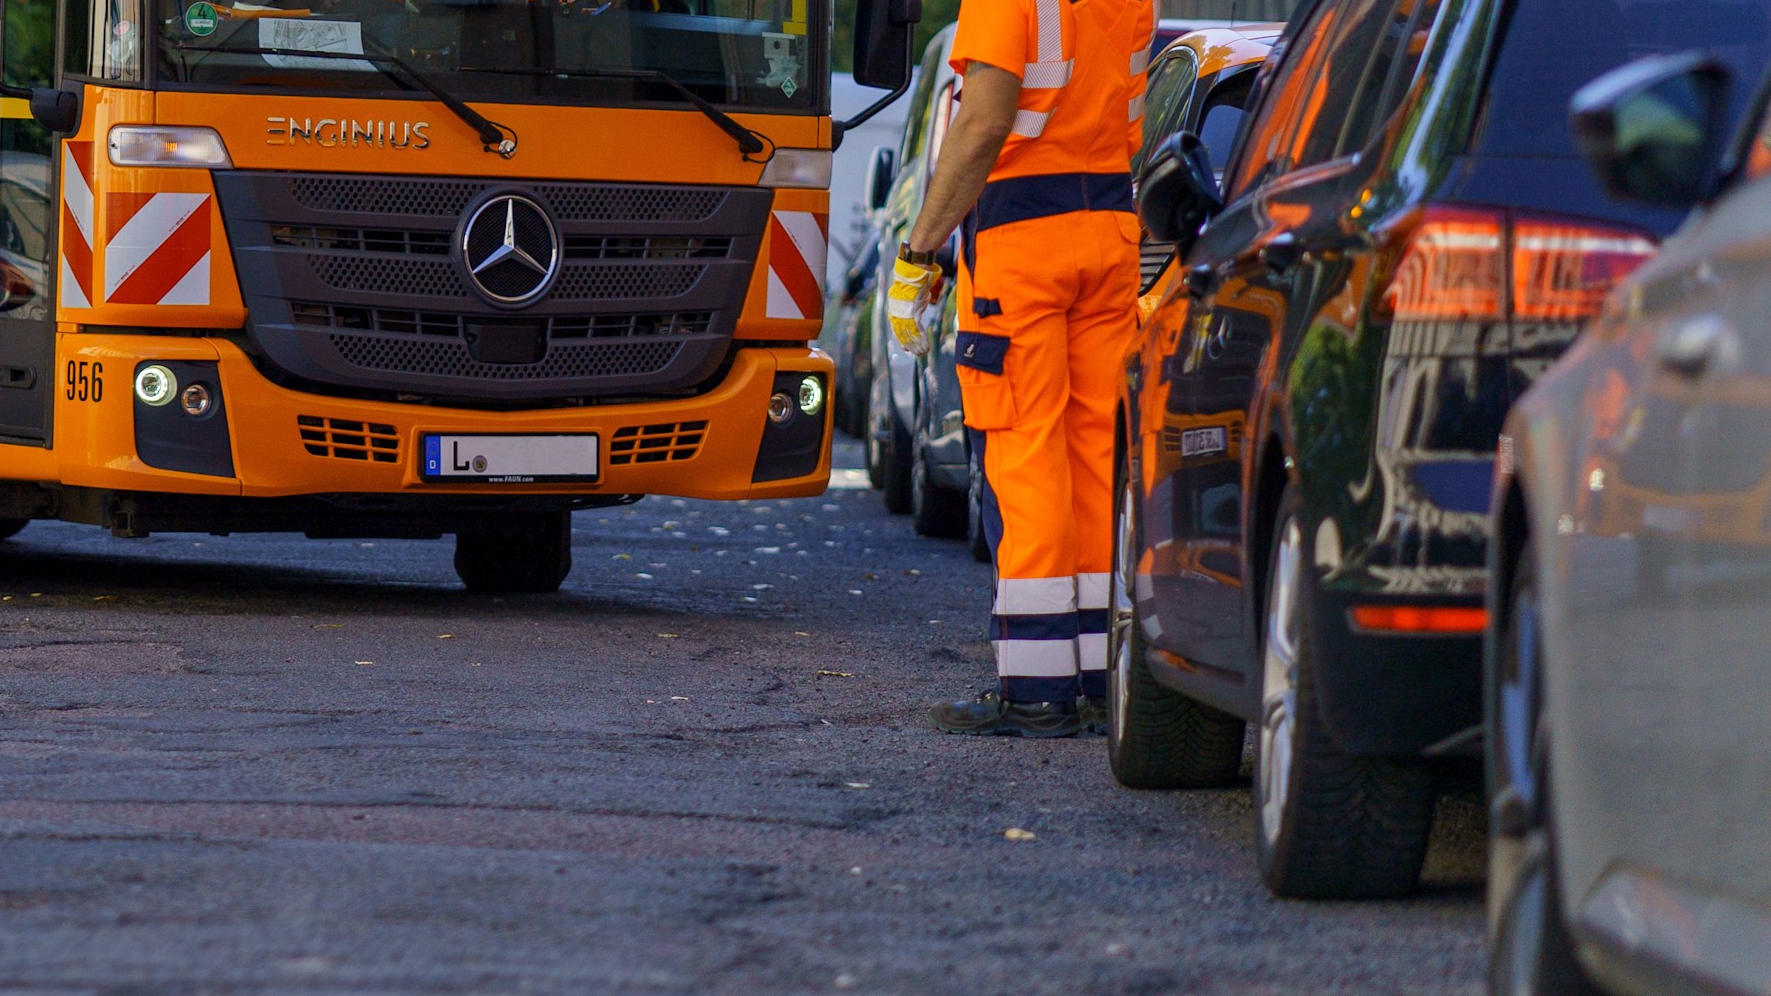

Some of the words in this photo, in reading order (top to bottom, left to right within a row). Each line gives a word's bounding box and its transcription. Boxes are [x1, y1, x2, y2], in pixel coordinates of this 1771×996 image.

[198, 4, 207, 19] 4
[267, 116, 430, 150] ENGINIUS
[67, 360, 103, 402] 956
[429, 459, 437, 470] D
[453, 441, 470, 471] L
